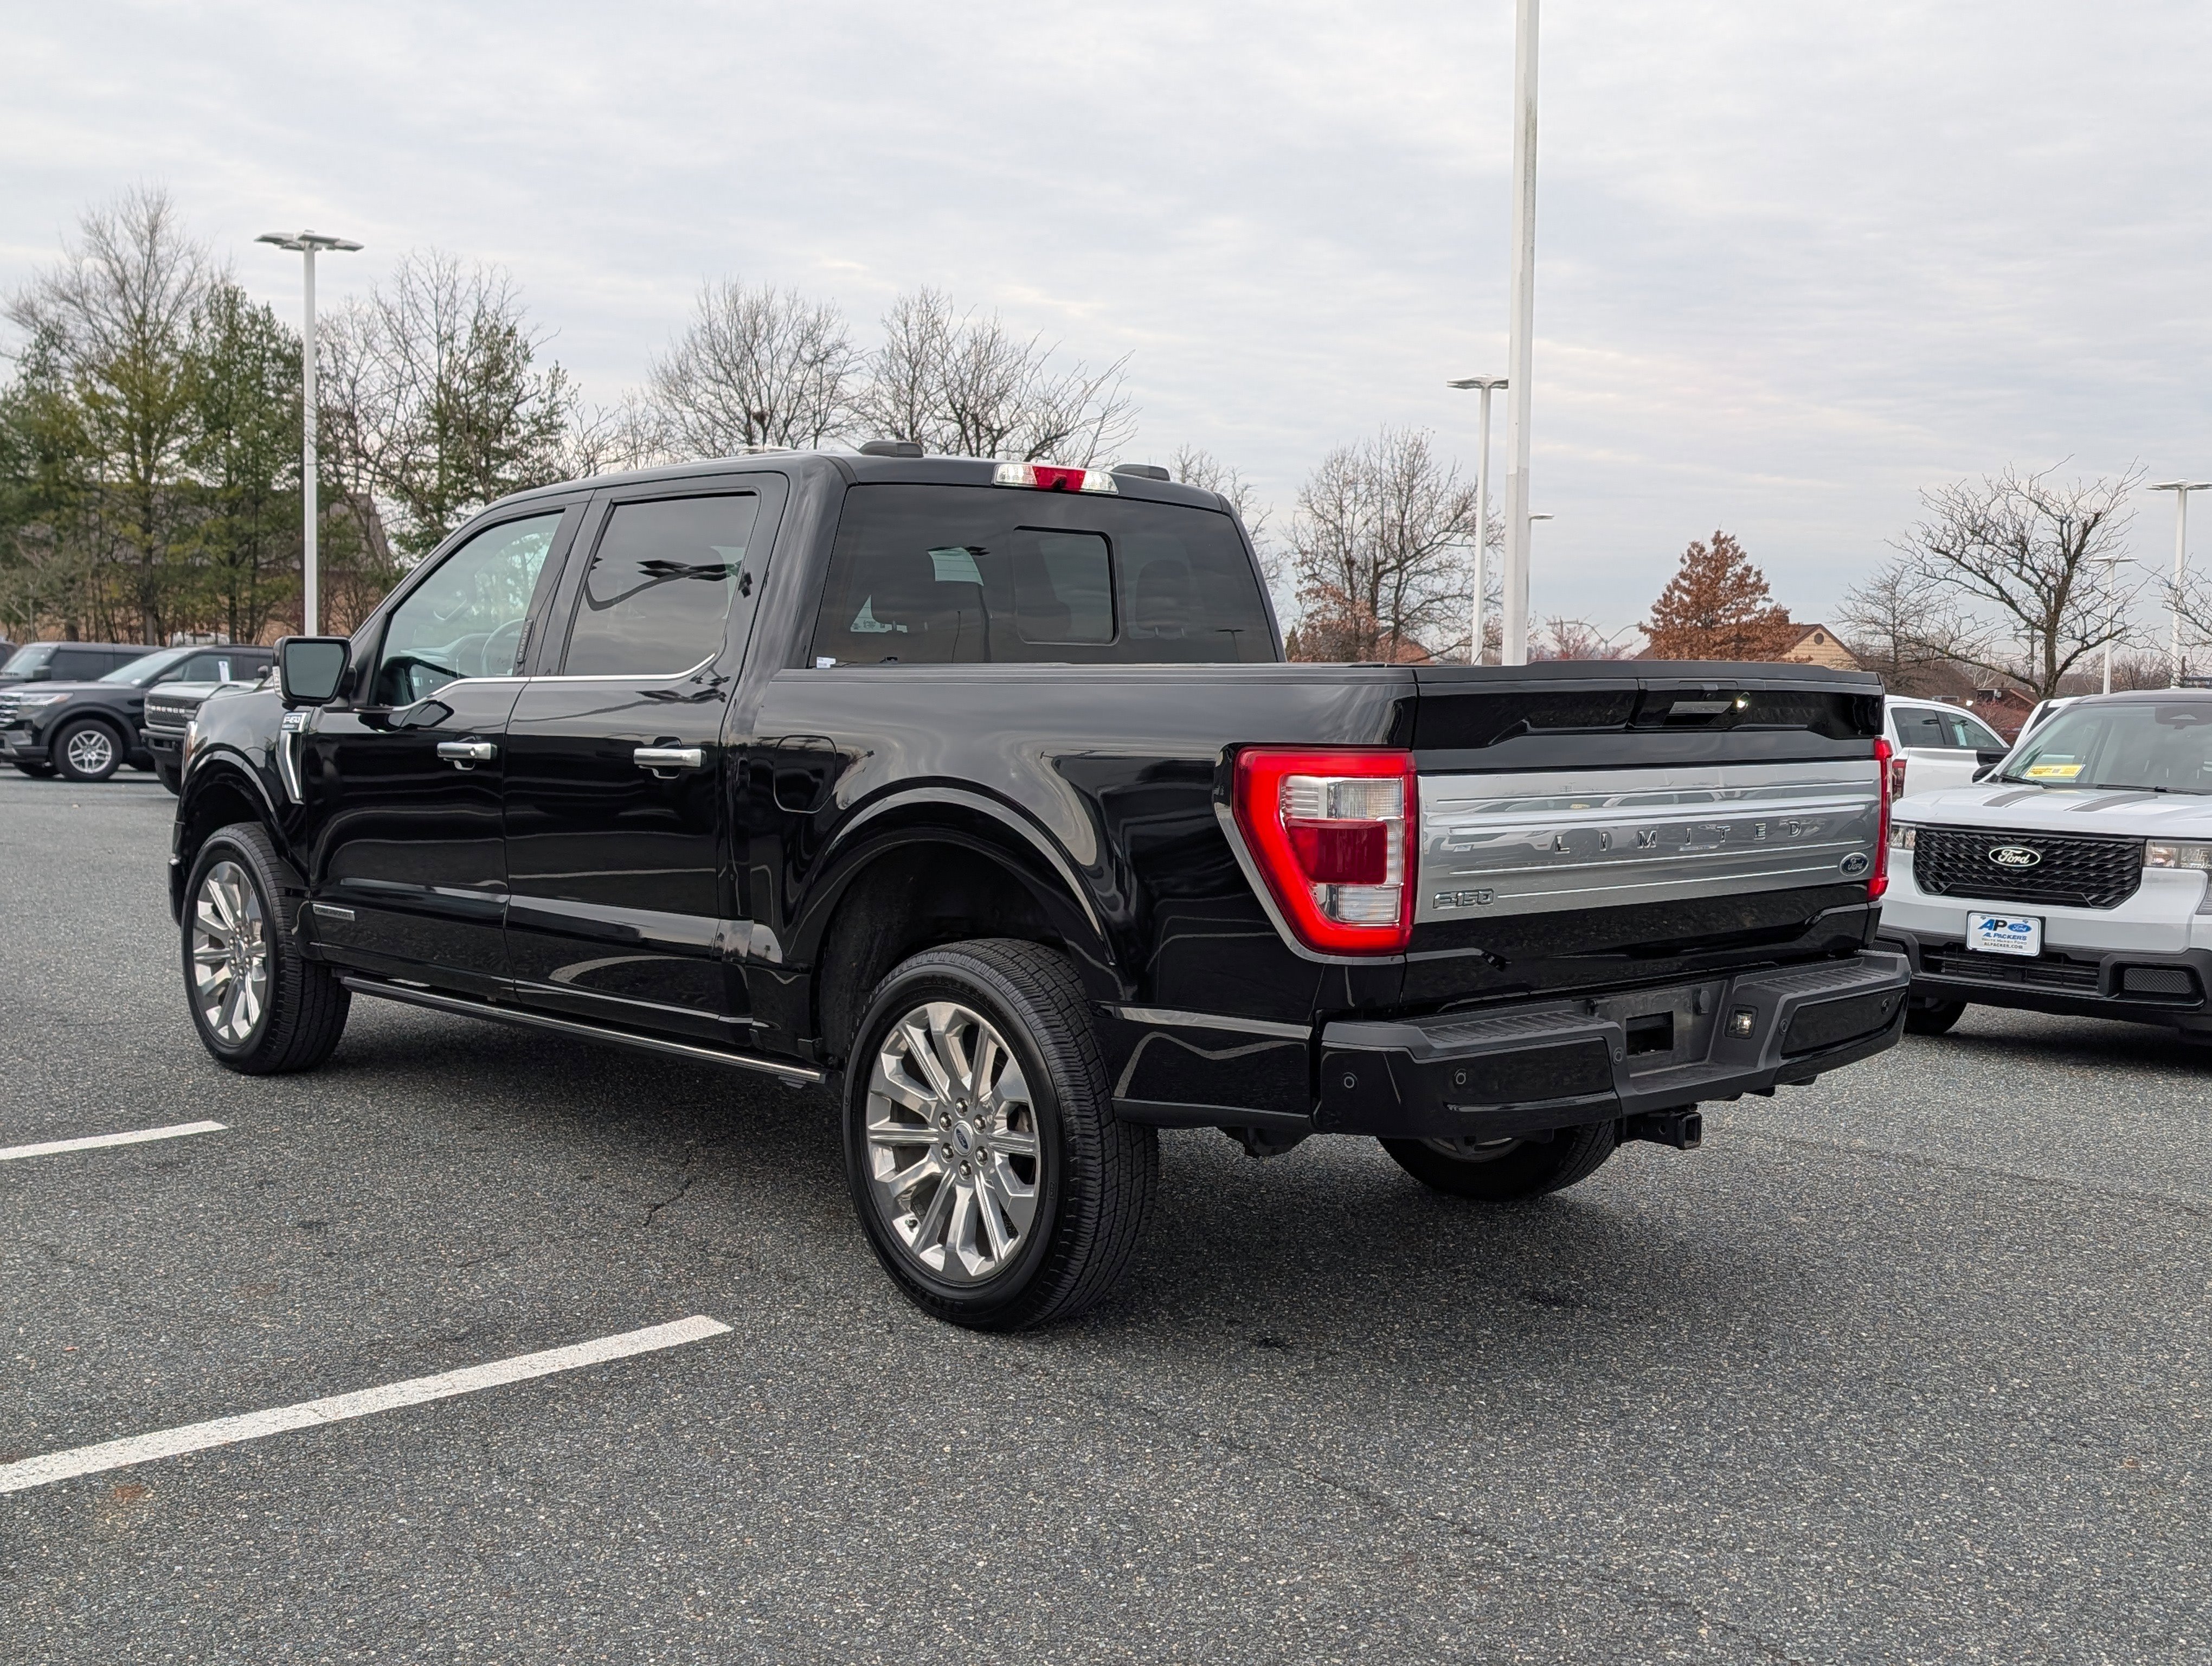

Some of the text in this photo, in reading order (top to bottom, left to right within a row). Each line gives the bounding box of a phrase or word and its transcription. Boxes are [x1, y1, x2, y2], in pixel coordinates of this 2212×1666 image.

[1554, 821, 1802, 855] LIMITED
[1998, 849, 2031, 864] Ford
[1433, 888, 1494, 909] F-150
[1977, 919, 2008, 931] AP
